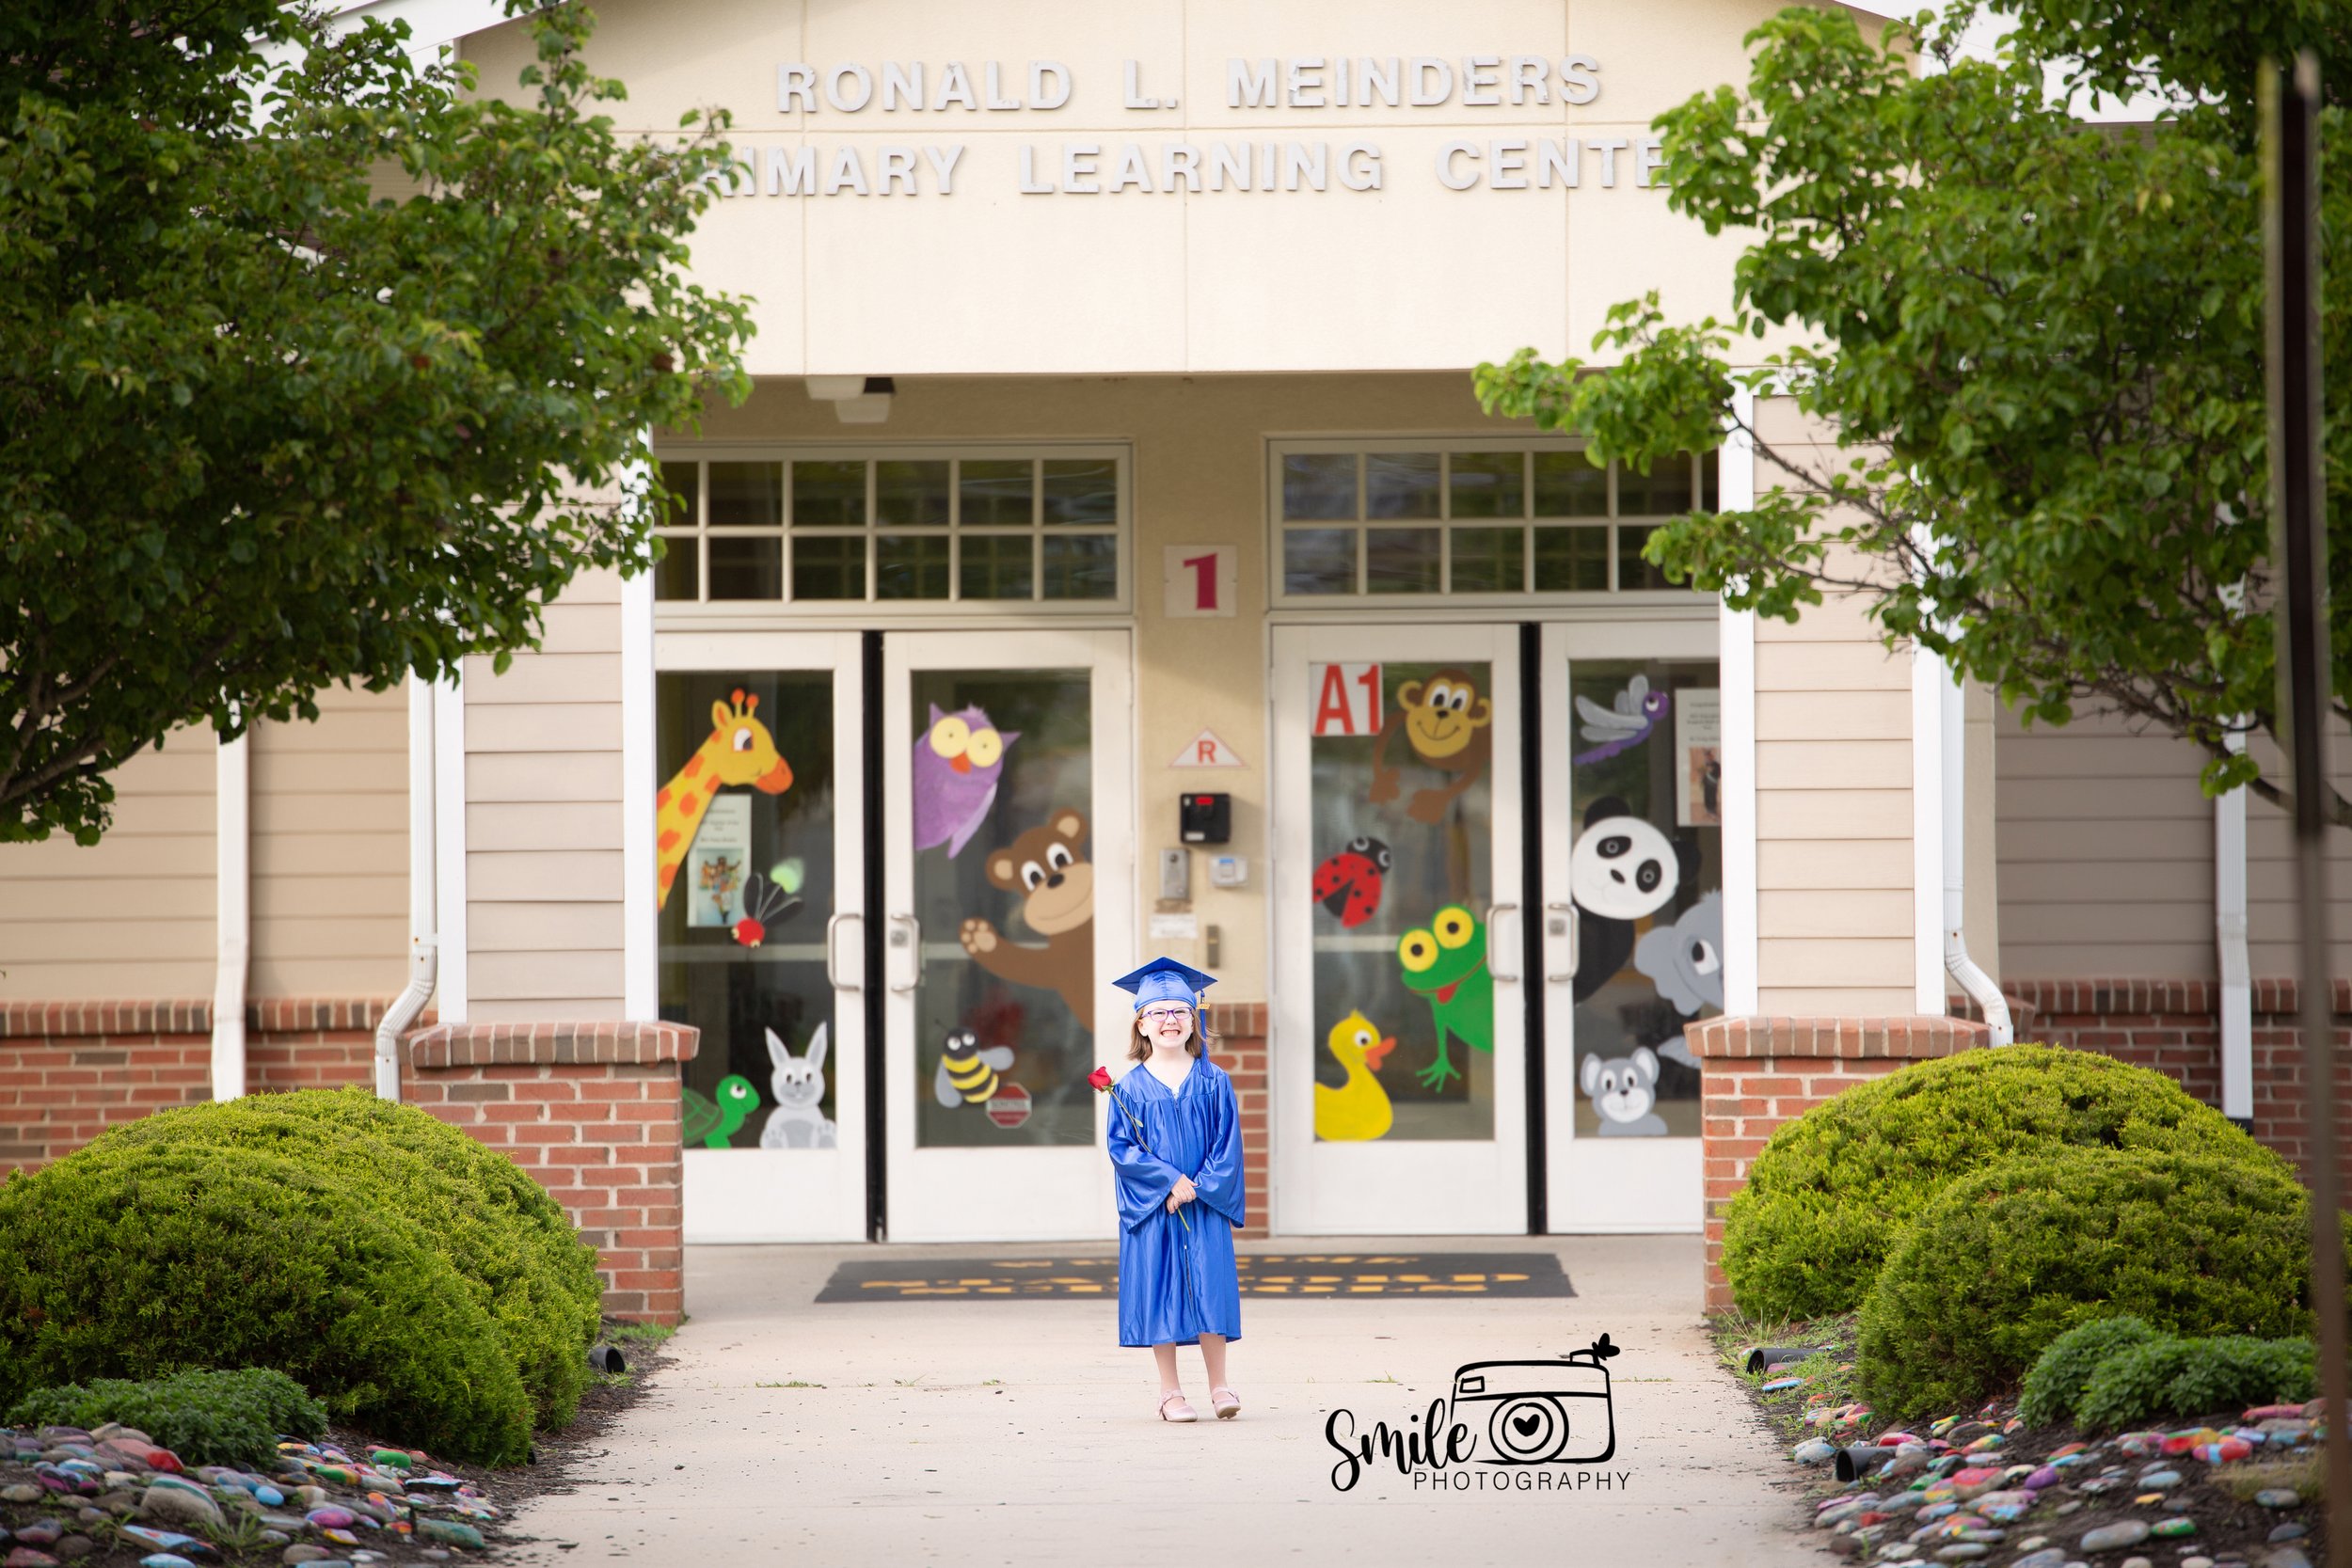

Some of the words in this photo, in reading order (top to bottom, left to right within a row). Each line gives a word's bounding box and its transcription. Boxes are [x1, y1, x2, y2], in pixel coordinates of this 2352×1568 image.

[777, 59, 1072, 113] RONALD
[1124, 58, 1178, 110] L.
[1227, 54, 1601, 108] MEINDERS
[1020, 140, 1383, 195] LEARNING
[1434, 138, 1678, 191] CENTE
[1182, 552, 1218, 610] 1
[1313, 664, 1381, 736] A1
[1197, 740, 1216, 765] R
